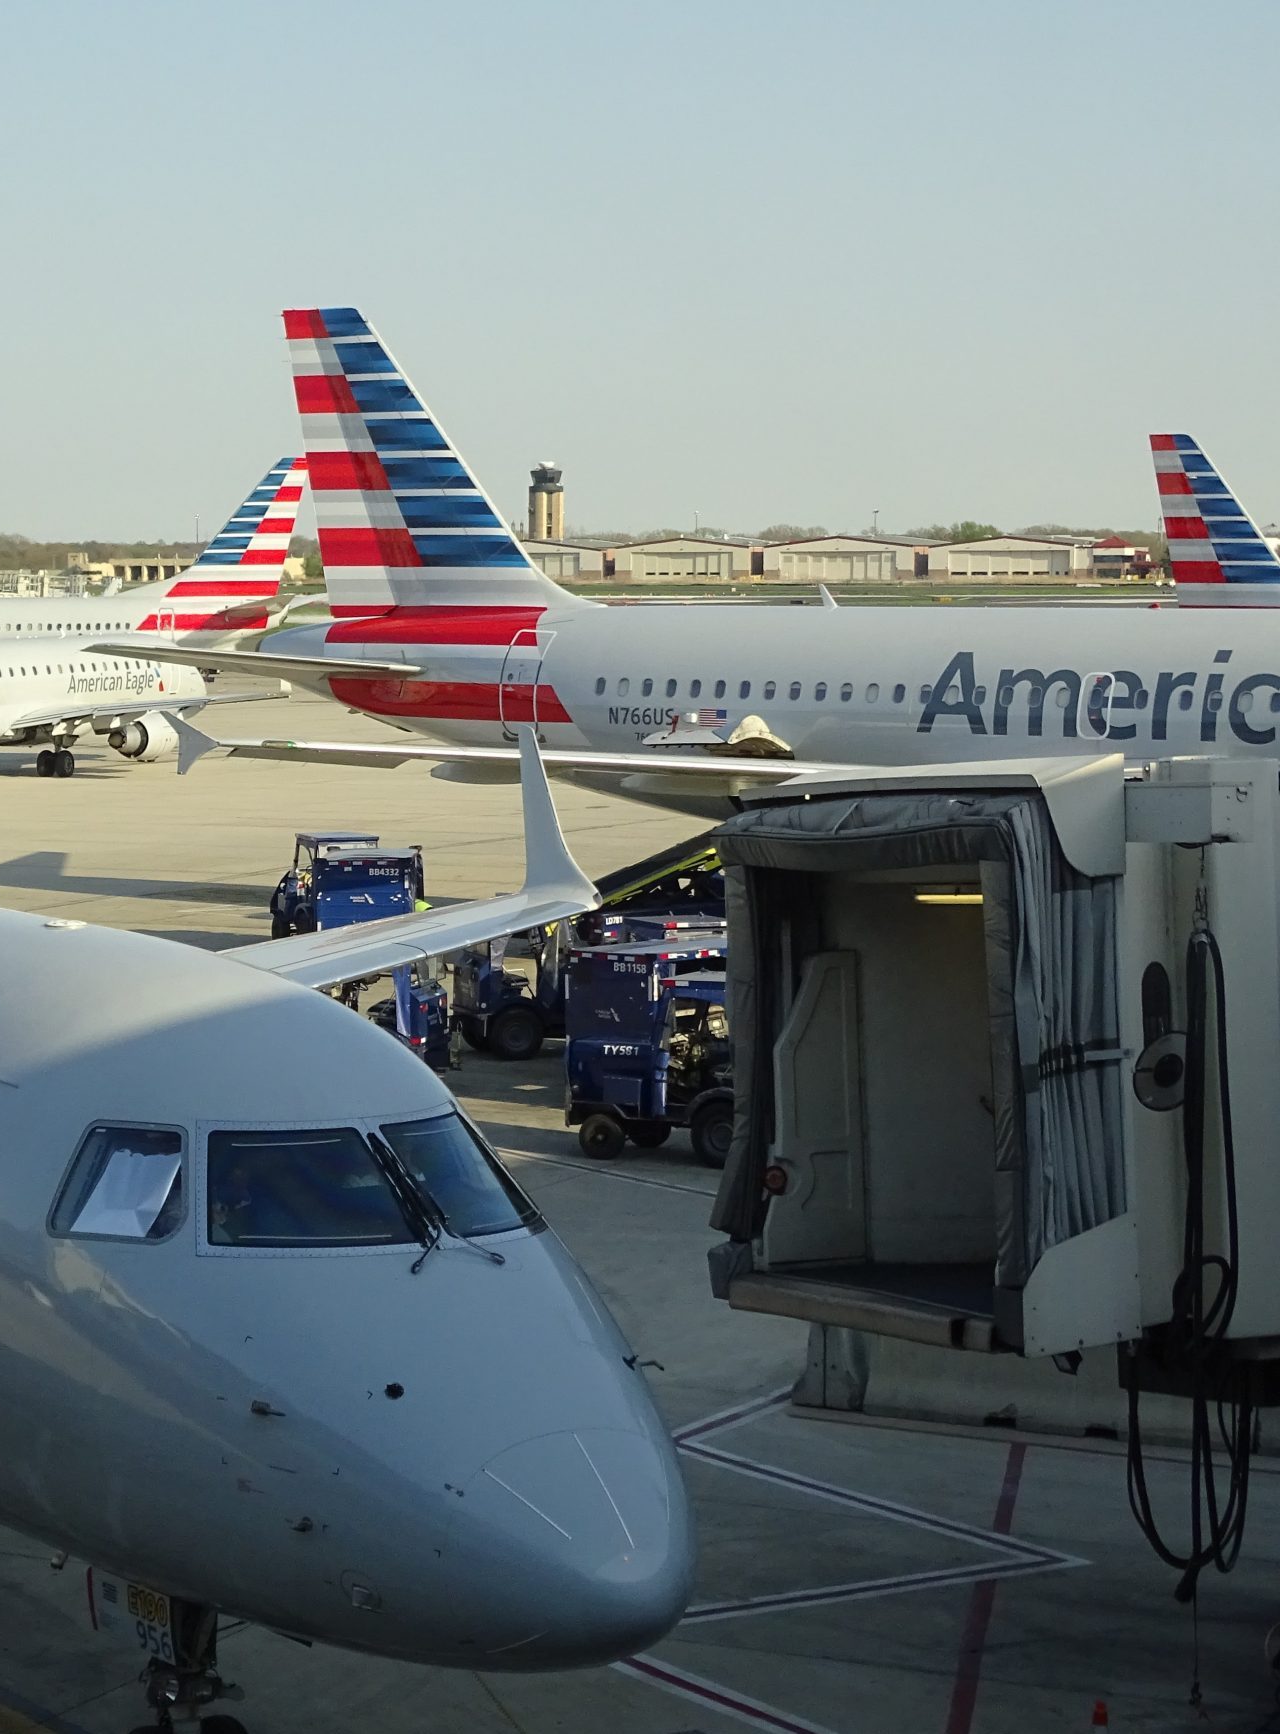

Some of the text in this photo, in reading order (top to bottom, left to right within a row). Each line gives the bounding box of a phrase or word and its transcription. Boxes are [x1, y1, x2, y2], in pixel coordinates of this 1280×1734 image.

[66, 669, 154, 695] American Eagle
[915, 648, 1280, 745] Americ
[608, 706, 675, 727] N766US
[368, 867, 400, 877] BB4332
[612, 960, 648, 975] BB1158
[602, 1043, 640, 1057] TY581
[126, 1583, 169, 1629] E190
[135, 1619, 173, 1661] 956
